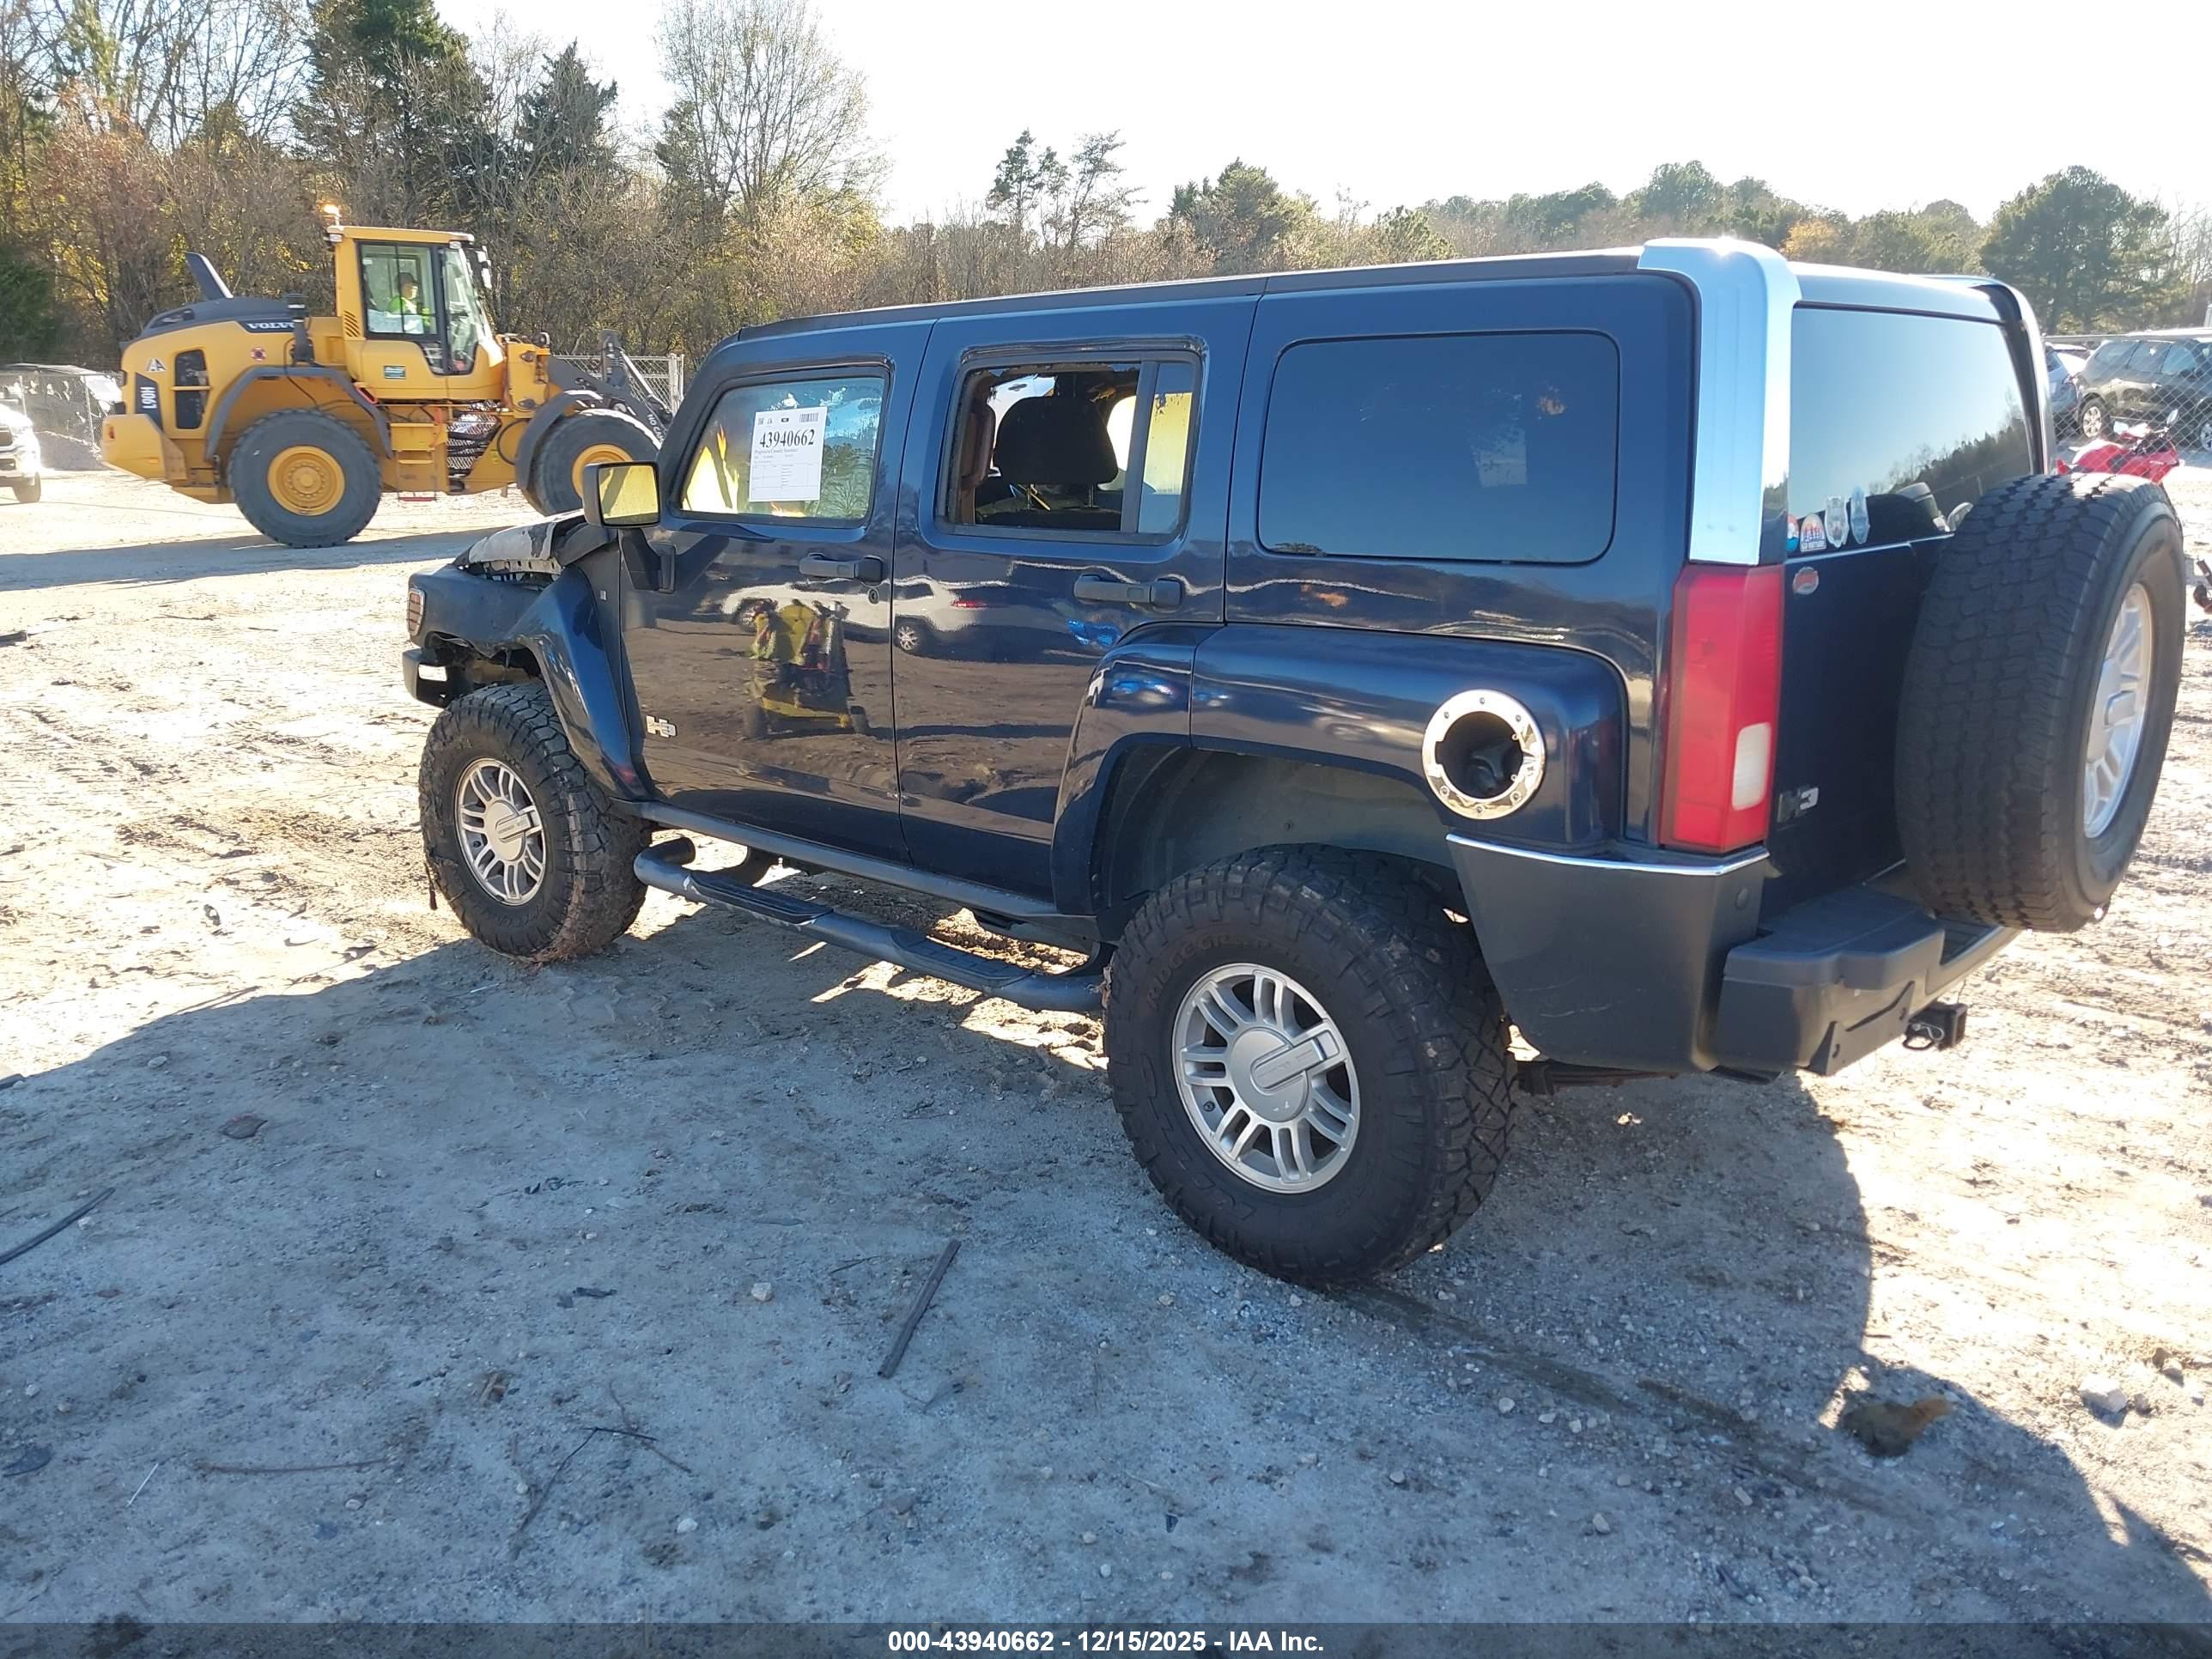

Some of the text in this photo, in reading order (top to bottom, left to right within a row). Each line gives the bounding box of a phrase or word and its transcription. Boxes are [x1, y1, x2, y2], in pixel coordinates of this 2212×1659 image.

[140, 386, 158, 410] L90H
[759, 428, 815, 448] 43940662
[646, 714, 677, 738] H3
[1777, 785, 1819, 823] H3
